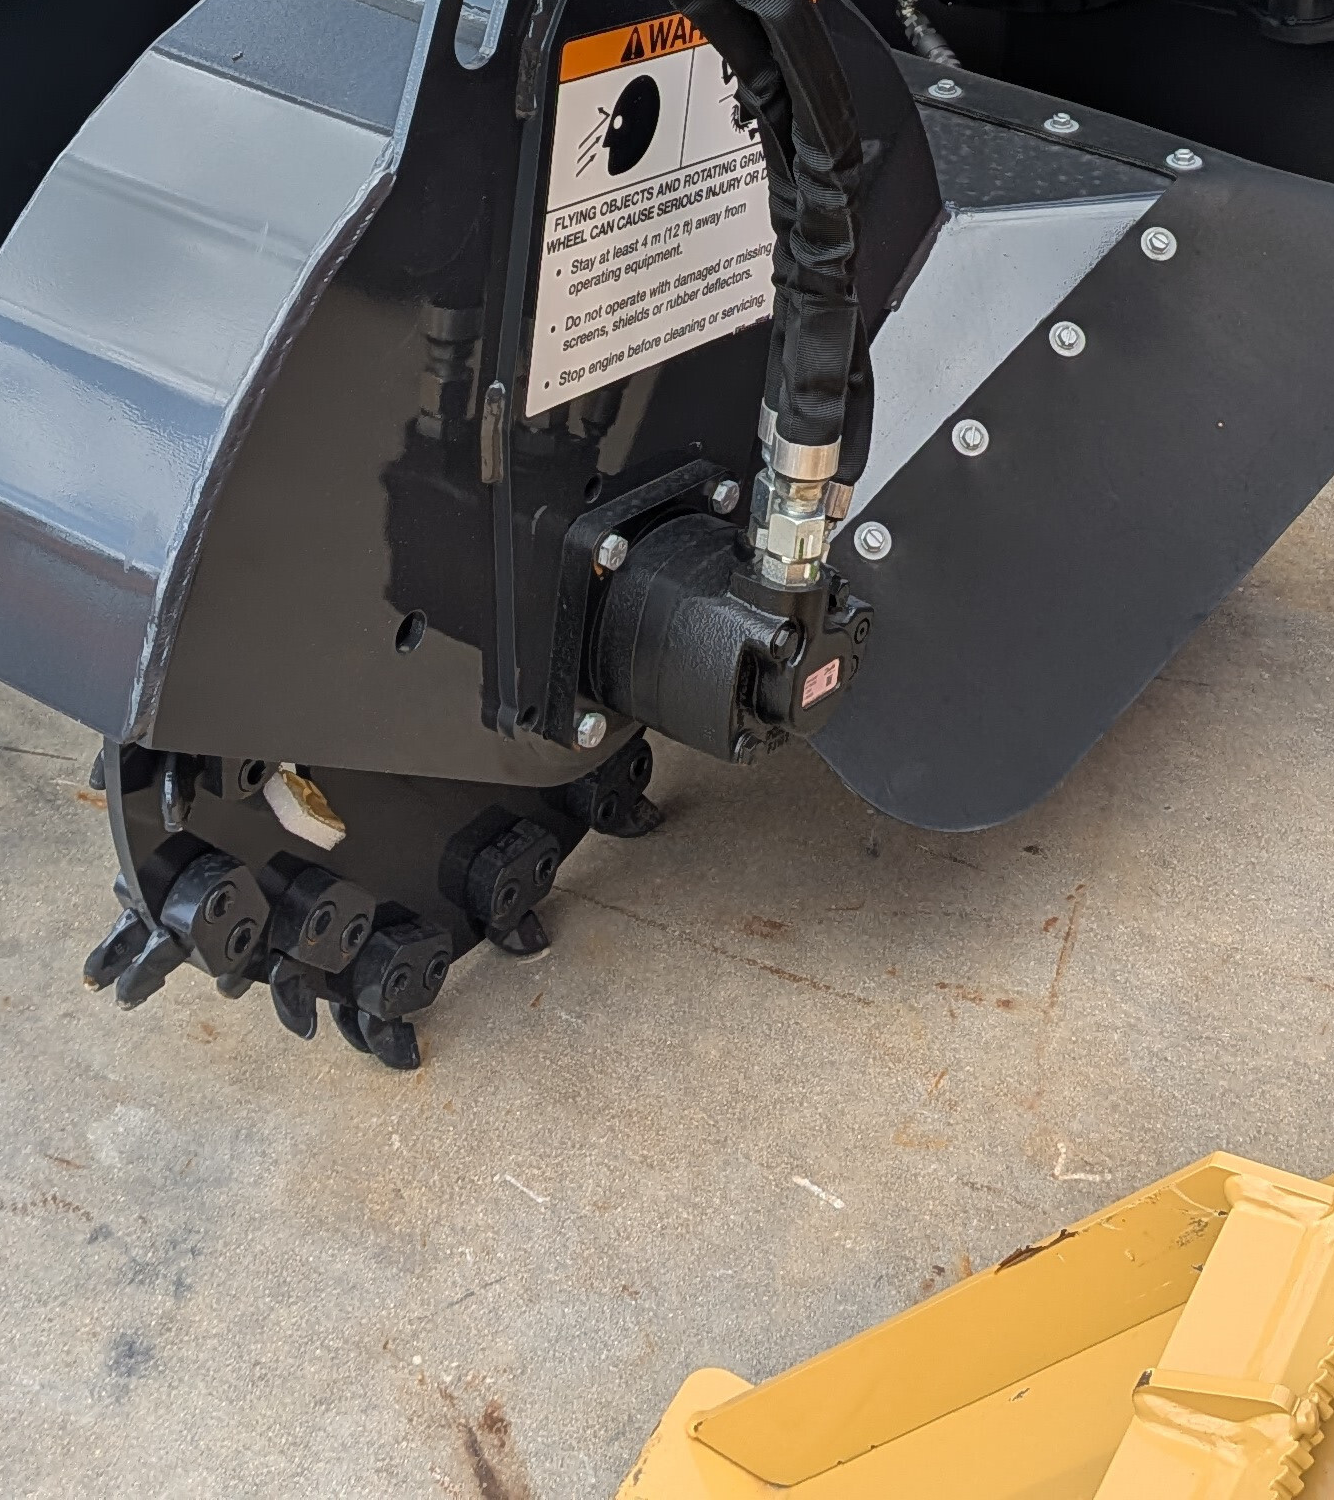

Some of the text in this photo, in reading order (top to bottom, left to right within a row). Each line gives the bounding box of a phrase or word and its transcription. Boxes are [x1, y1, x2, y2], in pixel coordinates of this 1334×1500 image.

[547, 229, 587, 255] WHEEL
[590, 219, 615, 239] CAN
[617, 205, 655, 230] CAUSE
[657, 189, 703, 217] SERIOUS
[705, 175, 743, 200] INJURY
[744, 170, 759, 186] OR
[554, 206, 597, 232] FLYING
[600, 186, 654, 216] OBJECTS
[655, 178, 680, 198] AND
[683, 159, 737, 188] ROTATING
[569, 243, 683, 296] operating equipment.
[570, 202, 746, 274] Stay at least 4 m (12 ft) away from
[562, 268, 752, 351] screens, shields or rubber deflectors.
[565, 242, 772, 331] Do not operate with damaged or missing
[558, 366, 585, 386] Stop
[588, 350, 624, 374] engine
[627, 336, 661, 358] before
[663, 316, 706, 344] cleaning
[708, 311, 719, 325] or
[721, 293, 766, 319] servicing.
